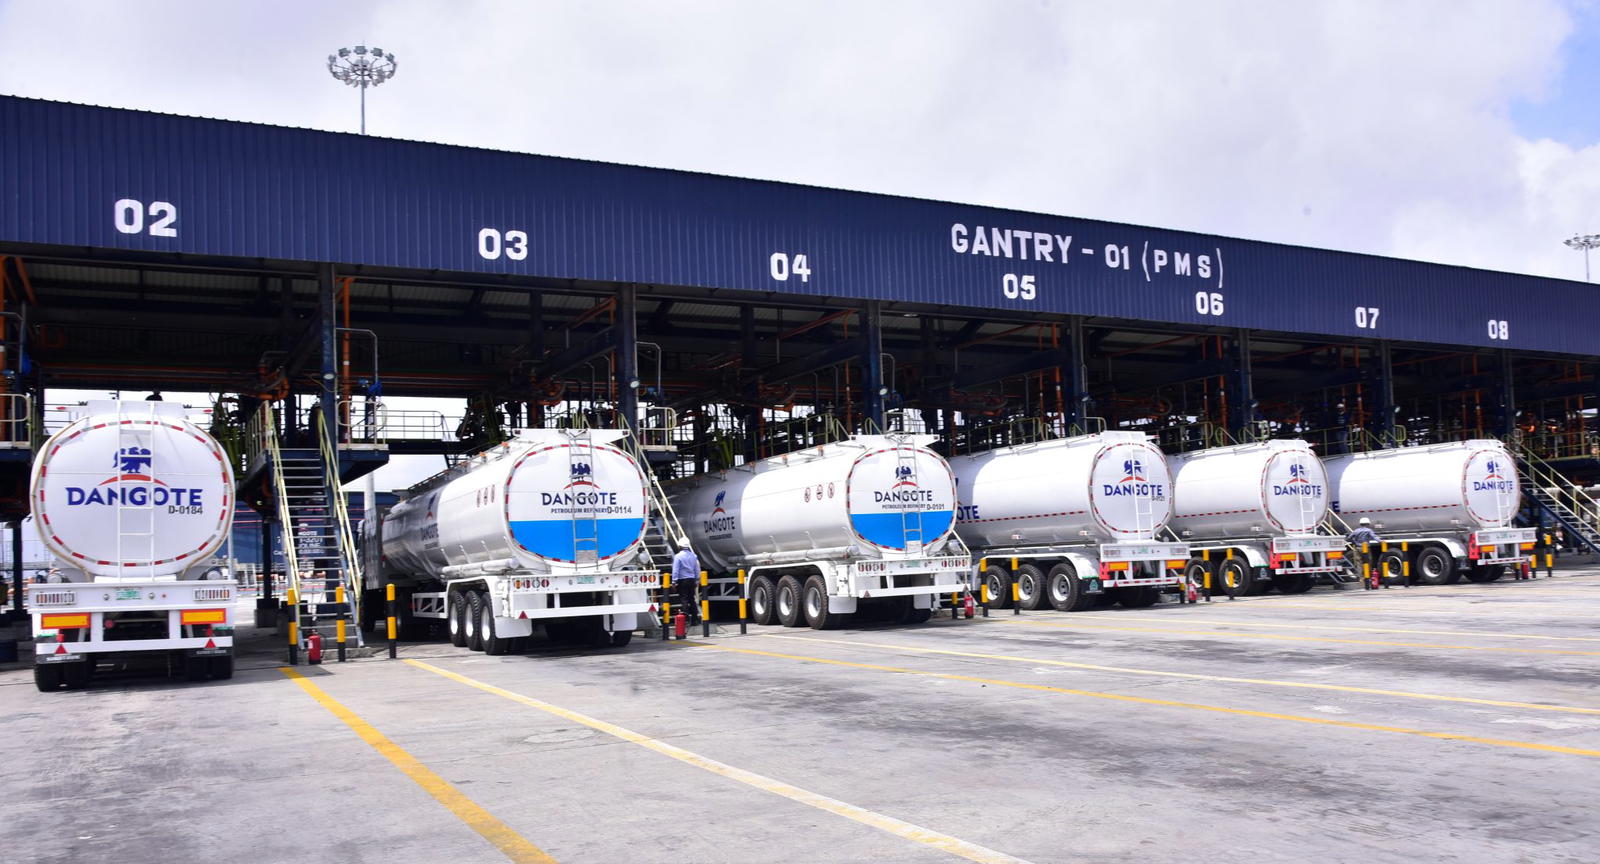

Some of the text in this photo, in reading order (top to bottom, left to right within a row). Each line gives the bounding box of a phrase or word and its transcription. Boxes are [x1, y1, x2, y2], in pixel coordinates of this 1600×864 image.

[114, 199, 178, 238] 02
[478, 228, 528, 261] 03
[951, 223, 1072, 264] GANTRY
[1104, 243, 1130, 270] 01
[770, 252, 812, 283] 04
[1003, 273, 1036, 301] 05
[1195, 291, 1224, 316] 06
[1354, 306, 1380, 329] 07
[1487, 319, 1509, 341] 08
[65, 486, 203, 506] DANGOTE
[541, 492, 617, 506] DANGOTE
[874, 490, 933, 502] DANGOTE
[1103, 484, 1163, 496] DANGOTE
[1273, 485, 1322, 496] DANGOTE
[168, 505, 203, 515] D-0184
[703, 516, 736, 534] DANGOTE
